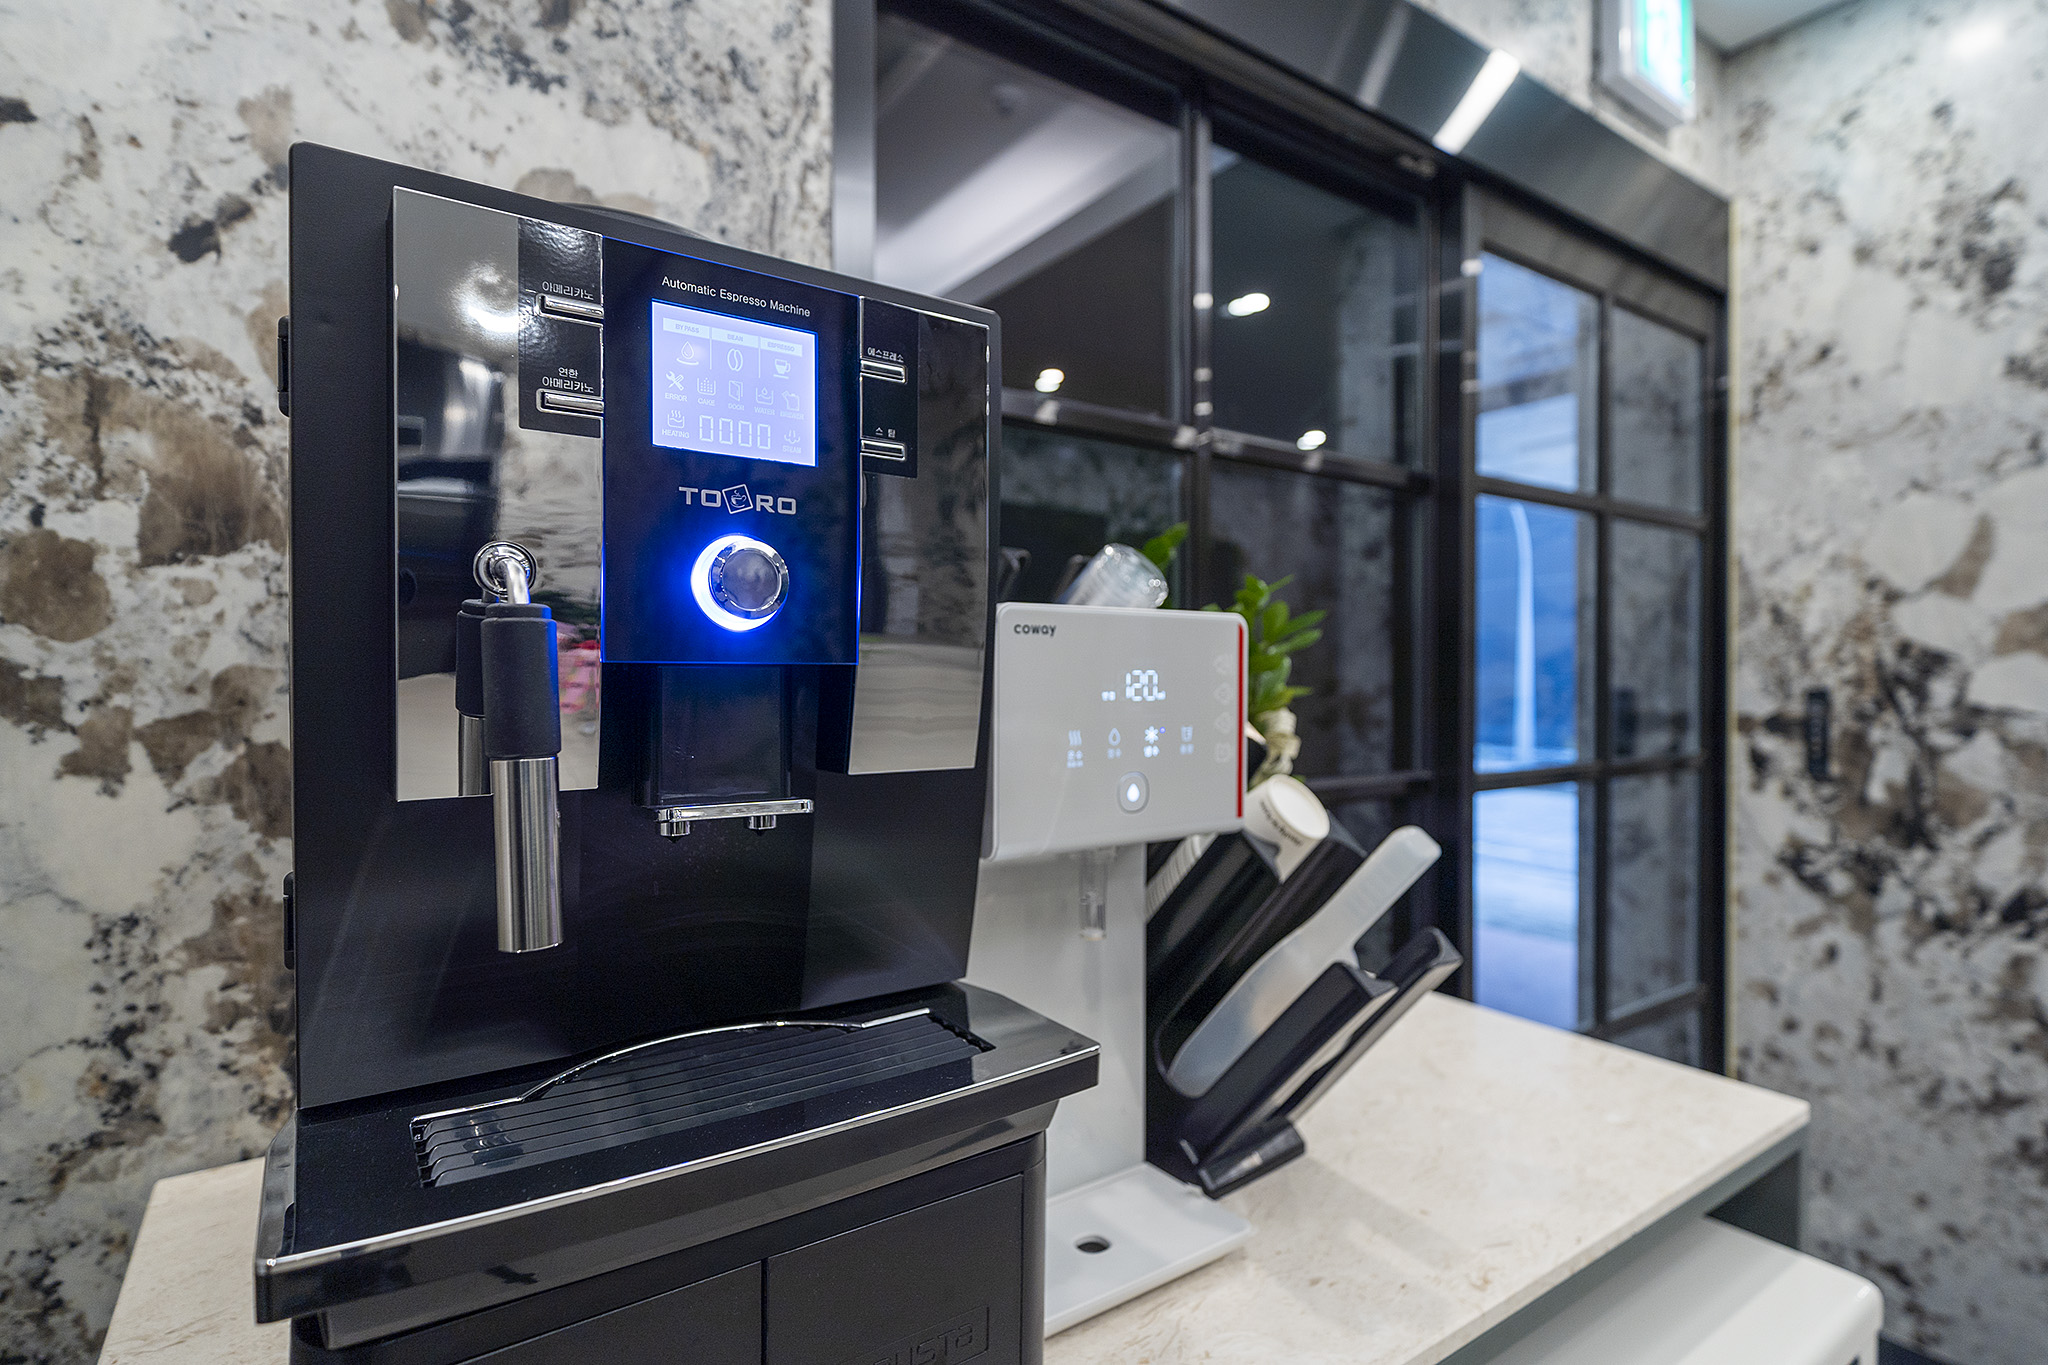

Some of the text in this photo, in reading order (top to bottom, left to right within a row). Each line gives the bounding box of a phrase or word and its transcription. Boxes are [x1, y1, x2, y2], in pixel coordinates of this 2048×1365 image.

[541, 280, 595, 301] 아메리카노
[661, 275, 811, 317] Automatic Espresso Machine
[867, 346, 904, 363] 에스프레소
[558, 367, 579, 379] 연한
[541, 376, 595, 394] 아메리카노
[664, 392, 688, 402] ERROR
[697, 397, 716, 407] CAKE
[753, 406, 776, 416] WATER
[661, 429, 690, 439] HEATING
[1125, 669, 1159, 701] 120
